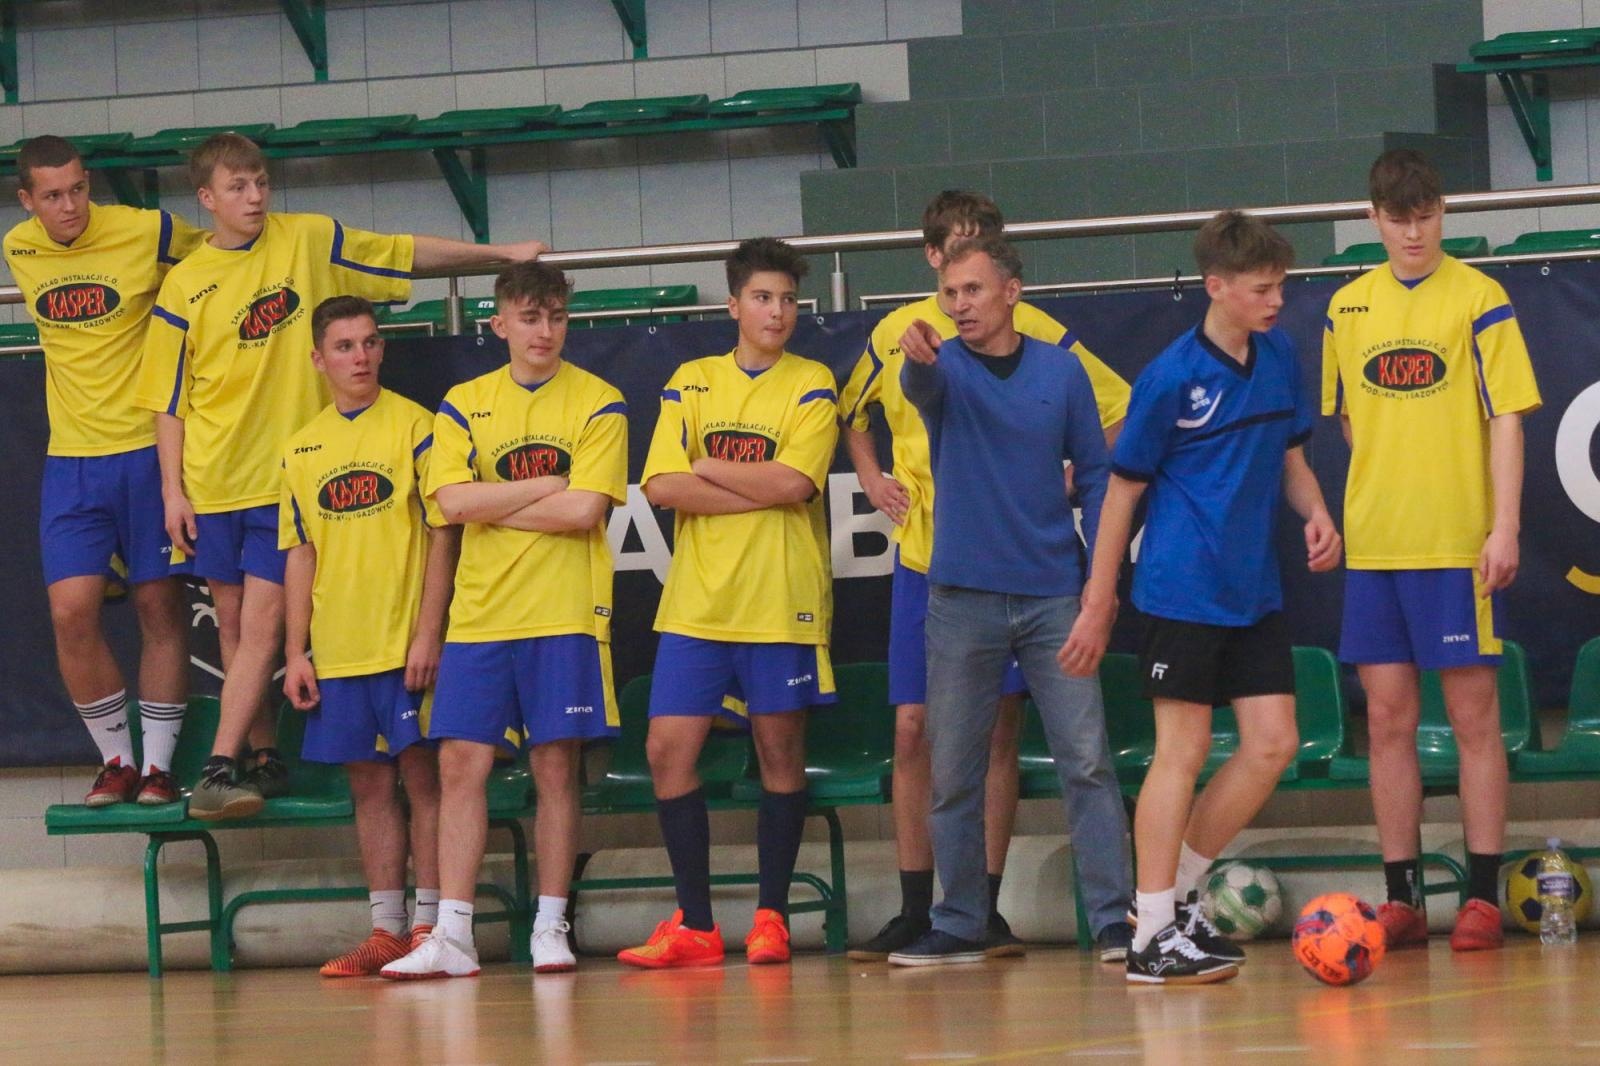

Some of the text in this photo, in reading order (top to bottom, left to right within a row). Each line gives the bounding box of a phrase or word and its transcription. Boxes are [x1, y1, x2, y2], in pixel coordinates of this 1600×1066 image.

[48, 287, 107, 319] KASPER
[188, 283, 218, 304] zina
[1338, 306, 1369, 314] zina
[1378, 353, 1435, 386] KASPER
[294, 444, 322, 454] zina
[326, 474, 380, 511] KASPER
[565, 705, 593, 714] zina
